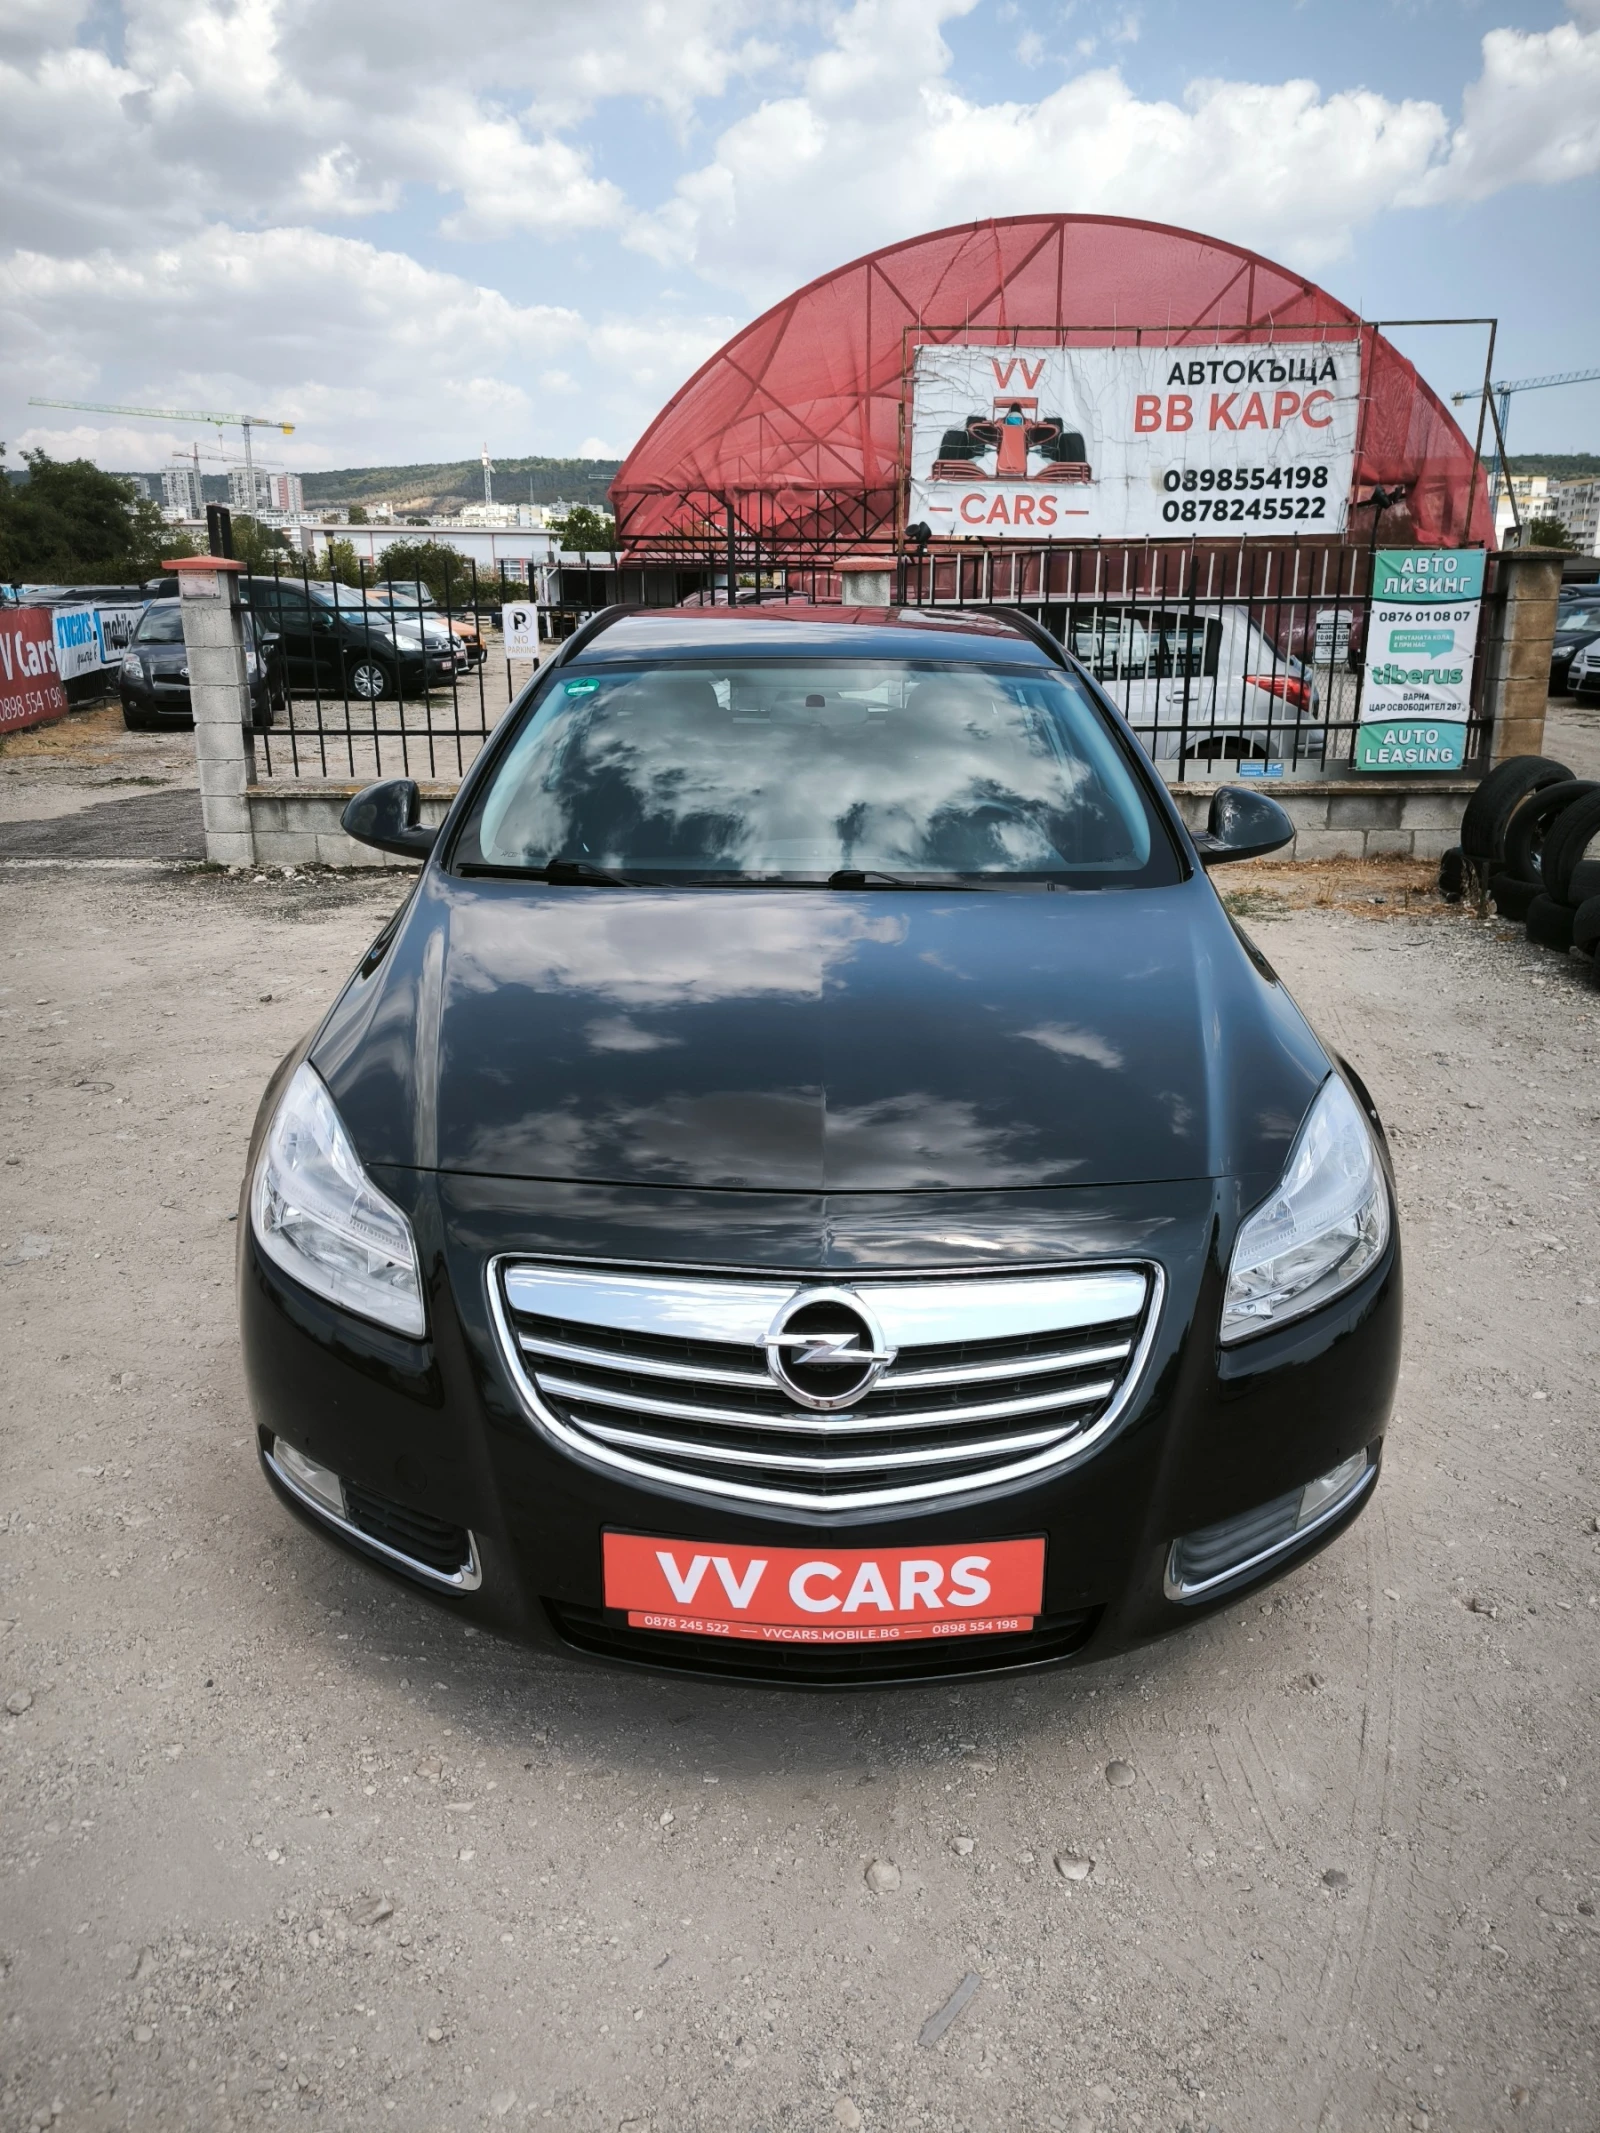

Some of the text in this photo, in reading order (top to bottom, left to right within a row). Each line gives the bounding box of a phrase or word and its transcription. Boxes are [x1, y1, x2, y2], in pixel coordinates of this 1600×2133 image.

[991, 357, 1046, 390] VV
[1166, 356, 1338, 386] АВТОКЪЩА
[1207, 389, 1335, 432] КАРС
[1163, 465, 1328, 493] 0898554198
[959, 493, 1059, 526] CARS
[1162, 496, 1326, 523] 0878245522
[1400, 556, 1458, 574] АВТО
[1382, 576, 1472, 594] ЛИЗИНГ
[1379, 610, 1471, 622] 0876 01 08 07
[507, 645, 536, 654] PARKING
[514, 635, 529, 644] NO
[14, 630, 57, 677] Cars
[1372, 663, 1463, 685] tiberus
[25, 690, 44, 715] 554
[44, 686, 63, 709] 198
[1368, 702, 1462, 712] ЦАР ОСВОБОДИТЕЛ 287
[1402, 693, 1430, 701] ВАРНА
[1382, 729, 1438, 745] AUTO
[1364, 747, 1454, 764] LEASING
[655, 1551, 992, 1613] VV CARS
[644, 1615, 1019, 1641] 0878 245 522 VVCARS.MOBILE.BG 0898 554 198
